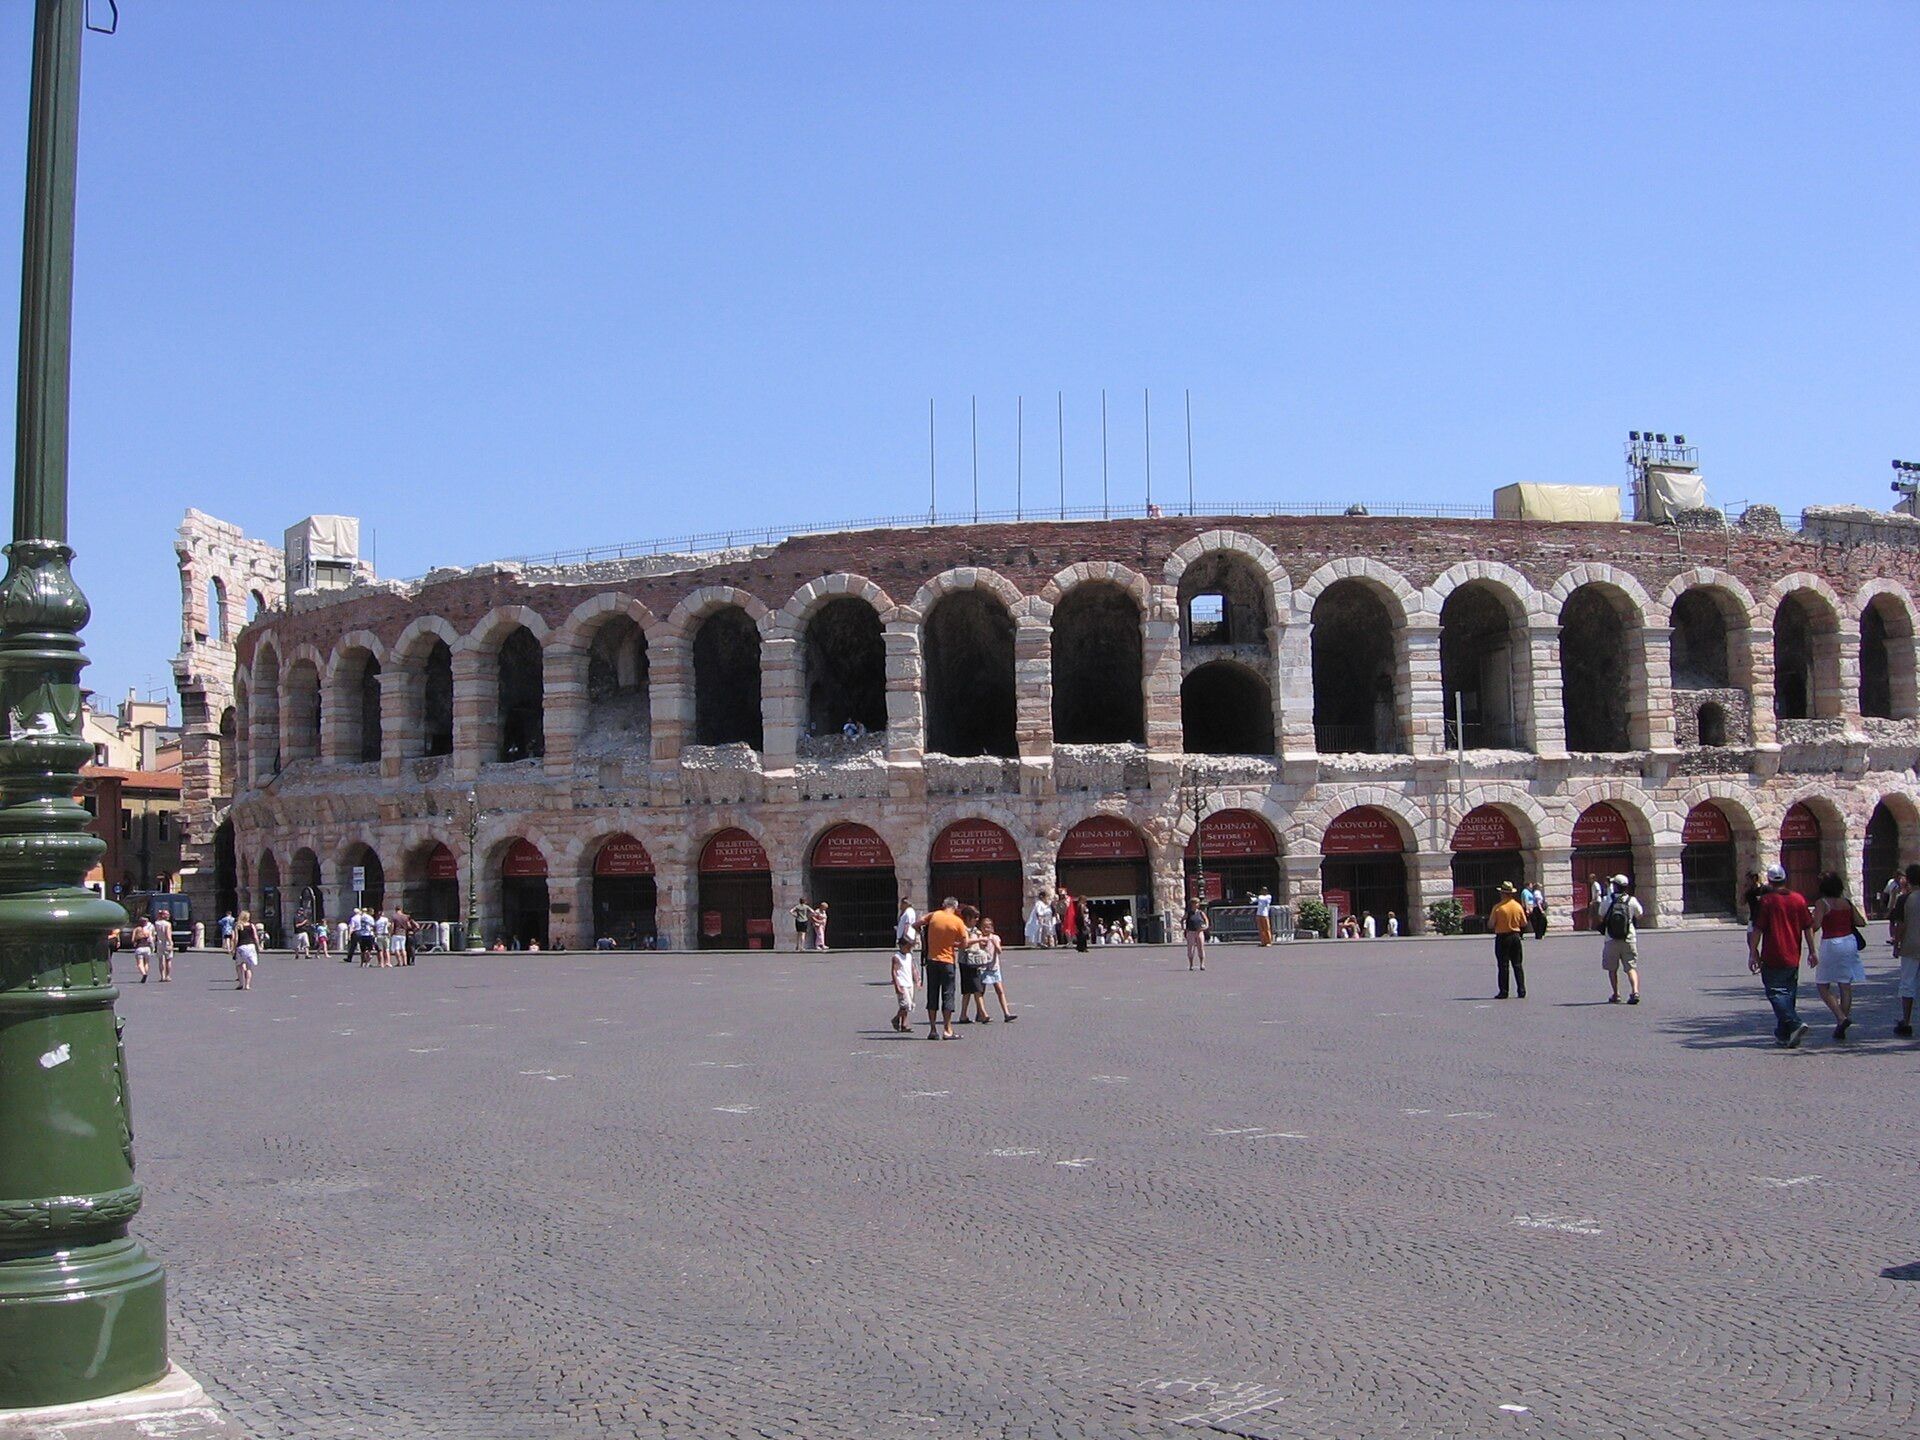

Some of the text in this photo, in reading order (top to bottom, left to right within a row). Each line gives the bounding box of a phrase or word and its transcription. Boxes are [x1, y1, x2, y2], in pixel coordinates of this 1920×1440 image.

[1201, 822, 1258, 831] GRADINATA
[1330, 821, 1376, 829] ARCOVOLO
[950, 830, 1002, 838] BIGLIETTERIA
[1069, 829, 1133, 839] ARENA SHOP
[949, 837, 1004, 846] TICKET OFFICE
